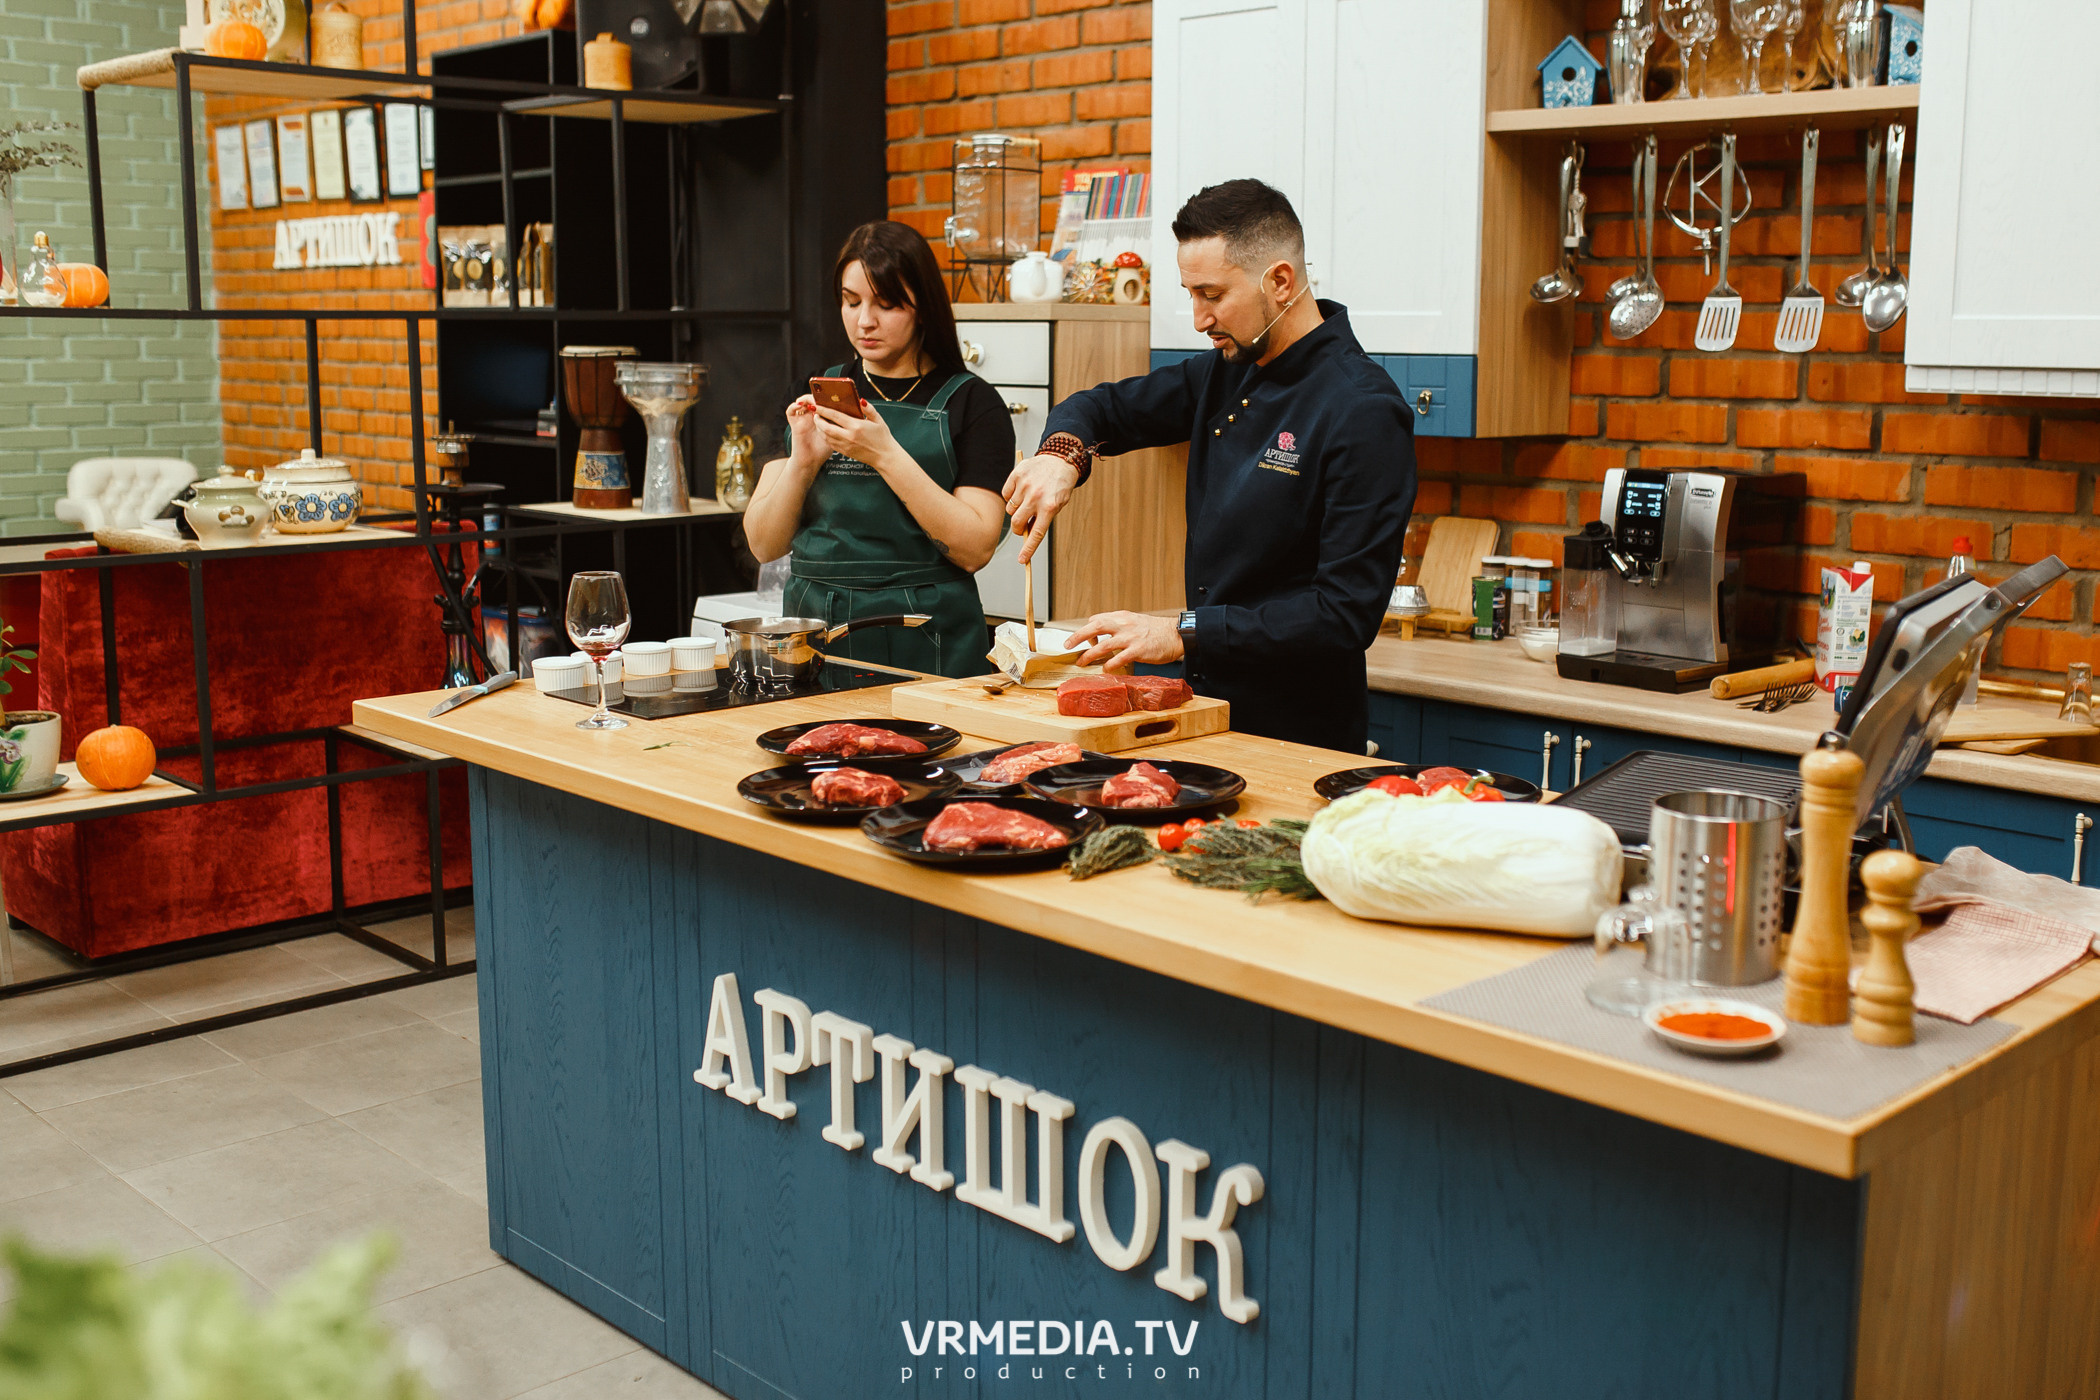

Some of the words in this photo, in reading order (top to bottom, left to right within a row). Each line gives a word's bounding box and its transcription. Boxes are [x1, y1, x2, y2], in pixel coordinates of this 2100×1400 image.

[273, 211, 402, 269] АРТИШОК
[825, 462, 864, 470] улинарная
[1264, 448, 1300, 464] АРТИШОК
[693, 971, 1266, 1325] АРТИШОК
